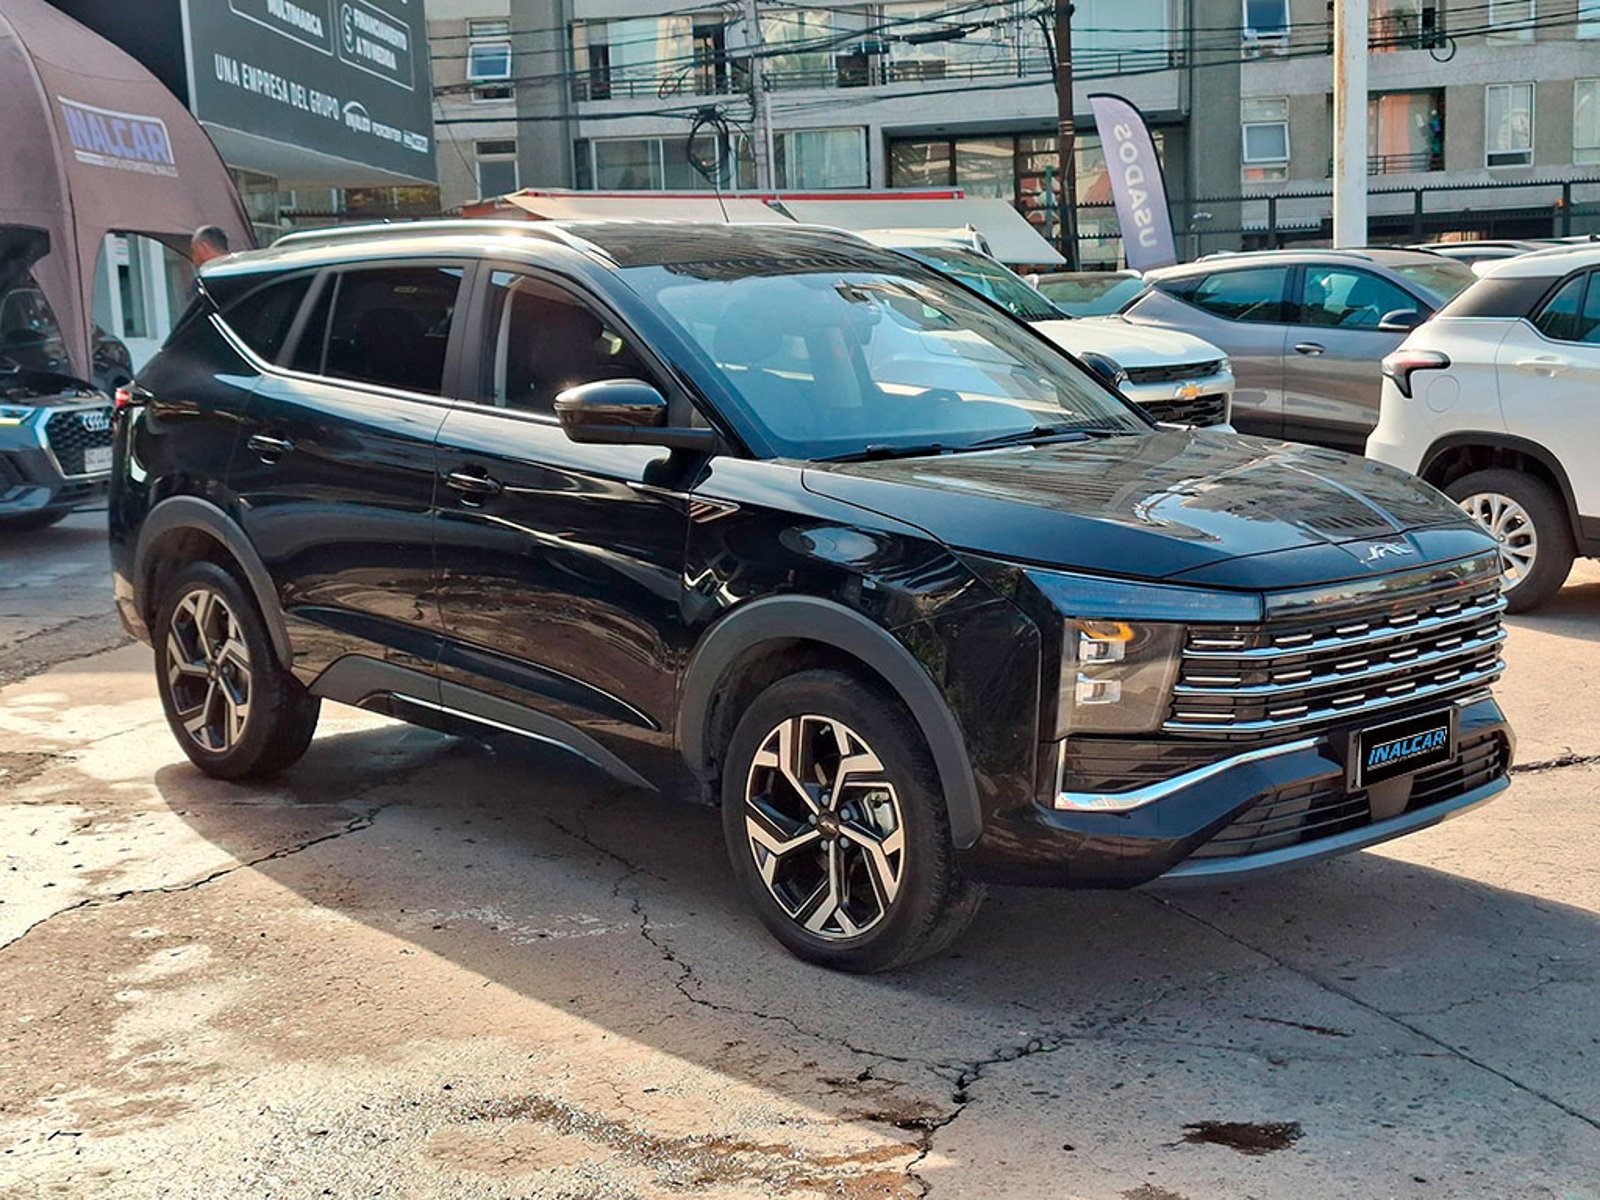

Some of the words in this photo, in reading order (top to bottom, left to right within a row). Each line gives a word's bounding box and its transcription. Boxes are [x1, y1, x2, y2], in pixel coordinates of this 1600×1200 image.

[214, 53, 240, 86] UNA
[241, 63, 289, 103] EMPRESA
[290, 82, 309, 111] DEL
[310, 90, 339, 120] GRUPO
[61, 105, 171, 164] INALCAR
